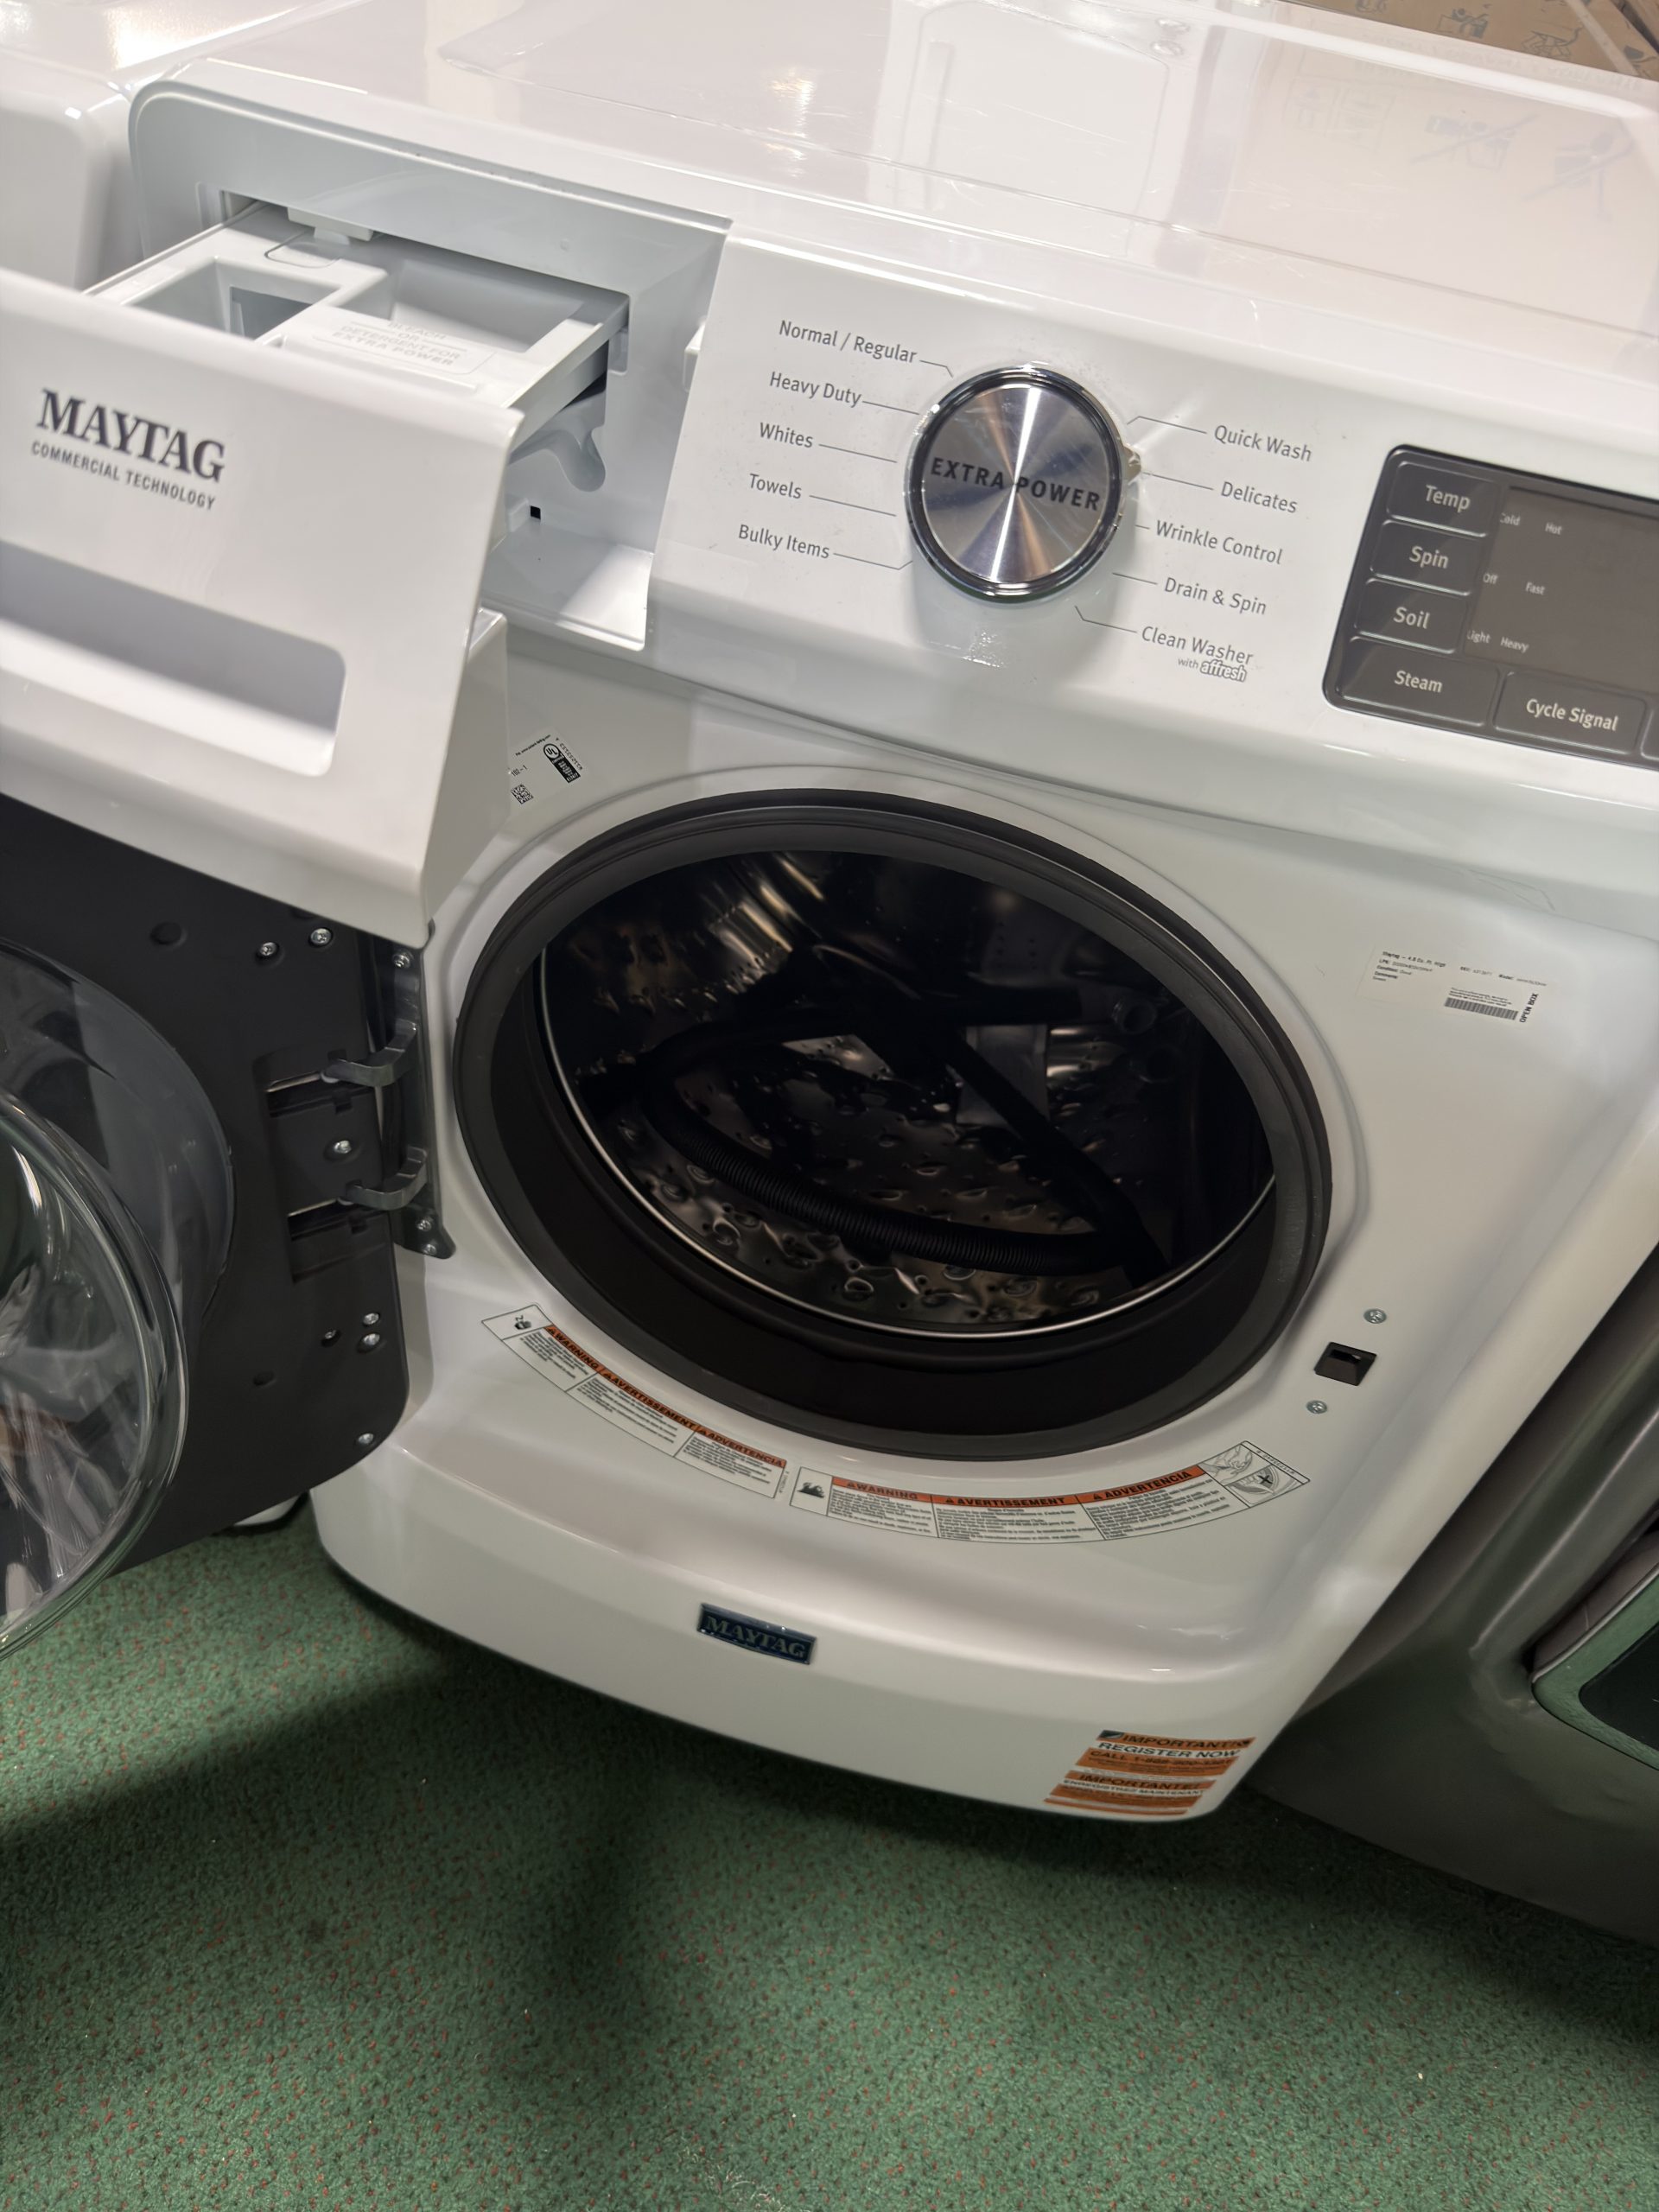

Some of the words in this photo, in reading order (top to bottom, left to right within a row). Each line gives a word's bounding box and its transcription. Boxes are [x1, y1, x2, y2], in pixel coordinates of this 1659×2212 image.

[387, 320, 448, 340] BLEACH
[779, 320, 838, 346] Normal
[840, 333, 851, 351] /
[853, 336, 917, 364] Regular
[332, 331, 388, 350] EXTRA
[391, 346, 454, 366] POWER
[770, 372, 820, 399] Heavy
[823, 384, 861, 408] Duty
[35, 387, 225, 483] MAYTAG
[759, 422, 814, 448] Whites
[1214, 424, 1261, 451] Quick
[1266, 436, 1313, 462] Wash
[31, 439, 120, 481] COMMERCIAL
[125, 470, 215, 511] TECHNOLOGY
[749, 474, 802, 499] Towels
[931, 457, 1005, 490] EXTRA
[1015, 475, 1101, 512] POWER
[1220, 481, 1298, 513] Delicates
[1425, 485, 1471, 513] Temp
[738, 524, 783, 550] Bulky
[786, 535, 830, 559] Items
[1155, 520, 1217, 549] Wrinkle
[1222, 537, 1283, 565] Control
[1545, 522, 1562, 535] Hot
[1409, 545, 1449, 569] Spin
[1164, 576, 1208, 601] Drain
[1212, 589, 1225, 606] &
[1229, 593, 1267, 616] Spin
[1483, 573, 1498, 584] Off
[1525, 582, 1545, 595] Fast
[1394, 607, 1430, 630] Soil
[1141, 626, 1186, 650] Clean
[1192, 637, 1254, 665] Washer
[1501, 637, 1529, 653] Heavy
[1178, 657, 1198, 670] with
[1199, 658, 1247, 683] affresh
[1395, 670, 1443, 693] Steam
[1526, 698, 1567, 720] Cycle
[1568, 708, 1619, 732] Signal
[1519, 1006, 1532, 1023] OPEN
[1527, 993, 1539, 1006] BOX
[555, 1332, 600, 1370] WARNING
[609, 1372, 696, 1428] AVERTISSEMENT
[707, 1430, 784, 1468] ADVERTENCIA
[855, 1482, 918, 1501] WARNING
[1105, 1471, 1192, 1498] ADVERTENCIA
[957, 1497, 1065, 1507] AVERTISSEMENT
[707, 1615, 805, 1658] MAYTAG
[1098, 1742, 1192, 1758] REGISTER
